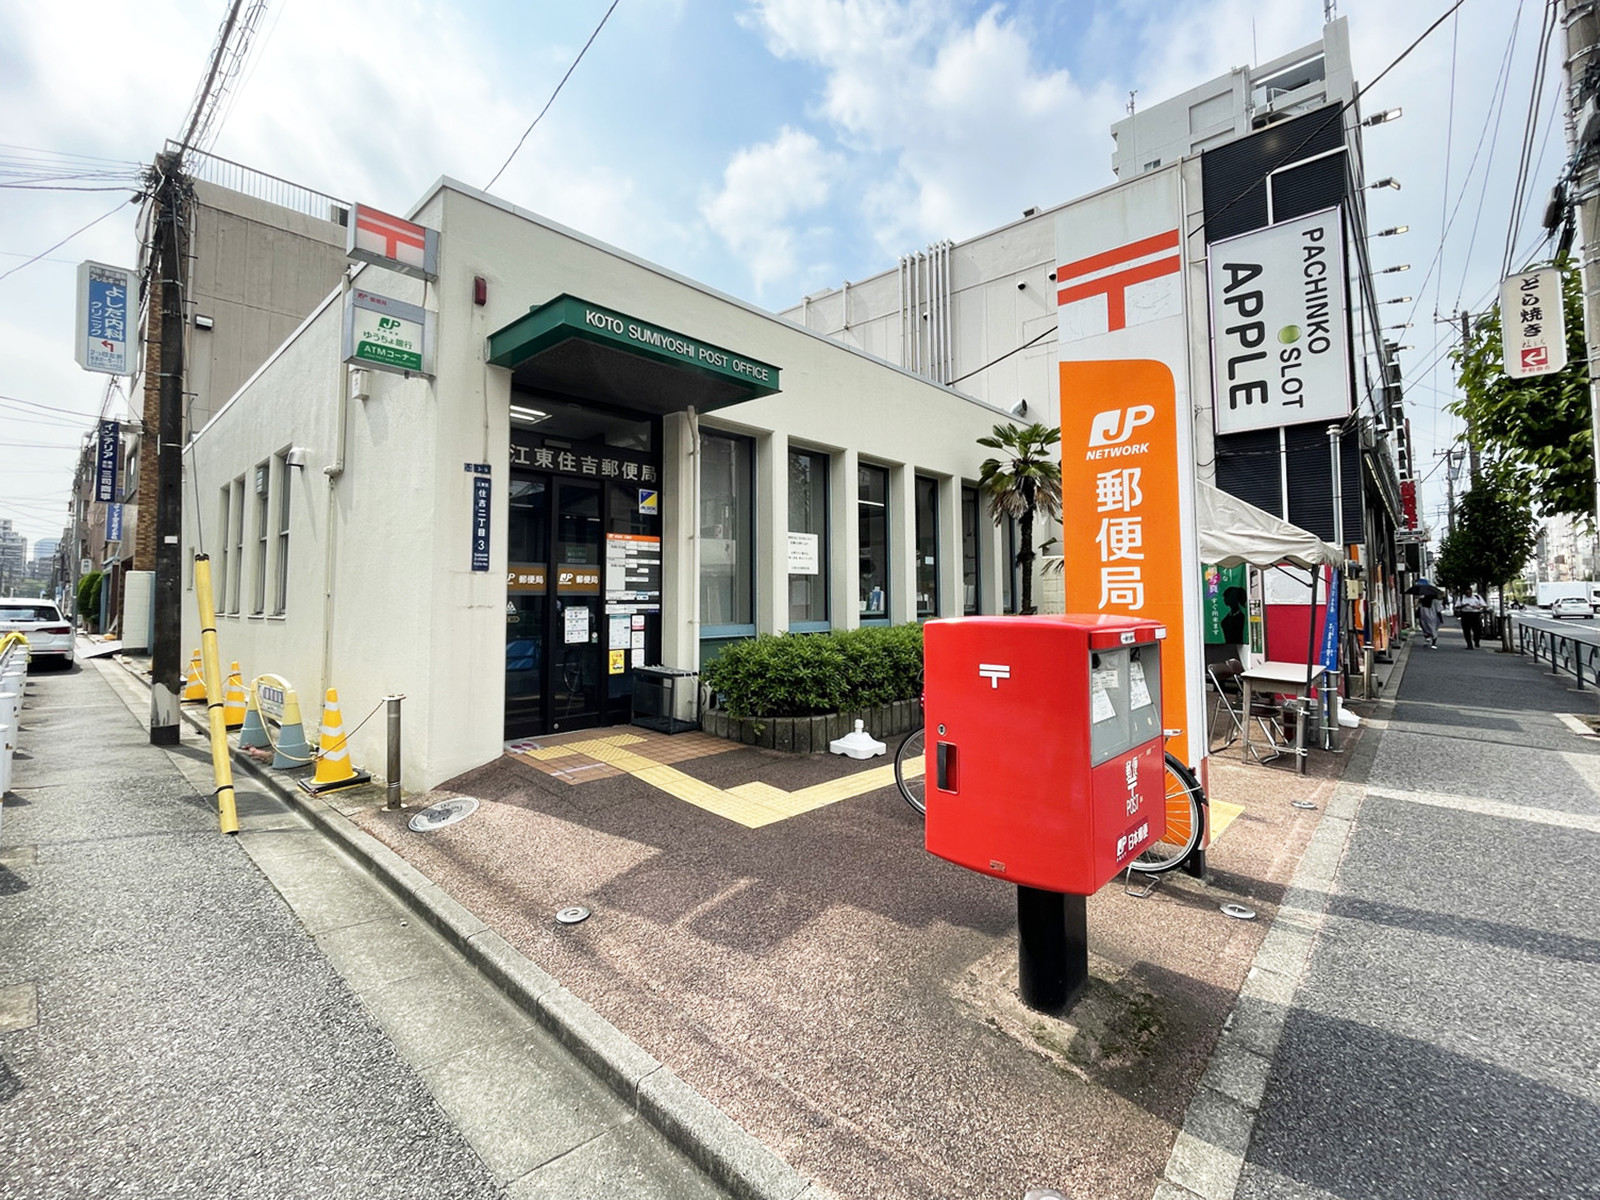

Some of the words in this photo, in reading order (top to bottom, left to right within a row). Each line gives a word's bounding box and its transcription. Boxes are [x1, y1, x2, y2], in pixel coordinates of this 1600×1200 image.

[105, 286, 124, 341] よしだ内科
[1302, 227, 1331, 354] PACHINKO
[1520, 274, 1543, 338] どら焼き
[363, 331, 413, 350] ゆうちょ銀行
[364, 345, 417, 361] ATMコーナー
[585, 310, 624, 334] KOTO
[628, 325, 695, 358] SUMIYOSHI
[699, 348, 728, 368] POST
[732, 360, 769, 382] OFFICE
[1222, 263, 1268, 410] APPLE
[1280, 347, 1304, 408] SLOT
[1086, 443, 1149, 460] NETWORK
[1088, 404, 1155, 448] JP
[510, 444, 657, 483] 江東住吉郵便局
[1095, 467, 1145, 610] 郵便局
[1126, 794, 1139, 816] POST
